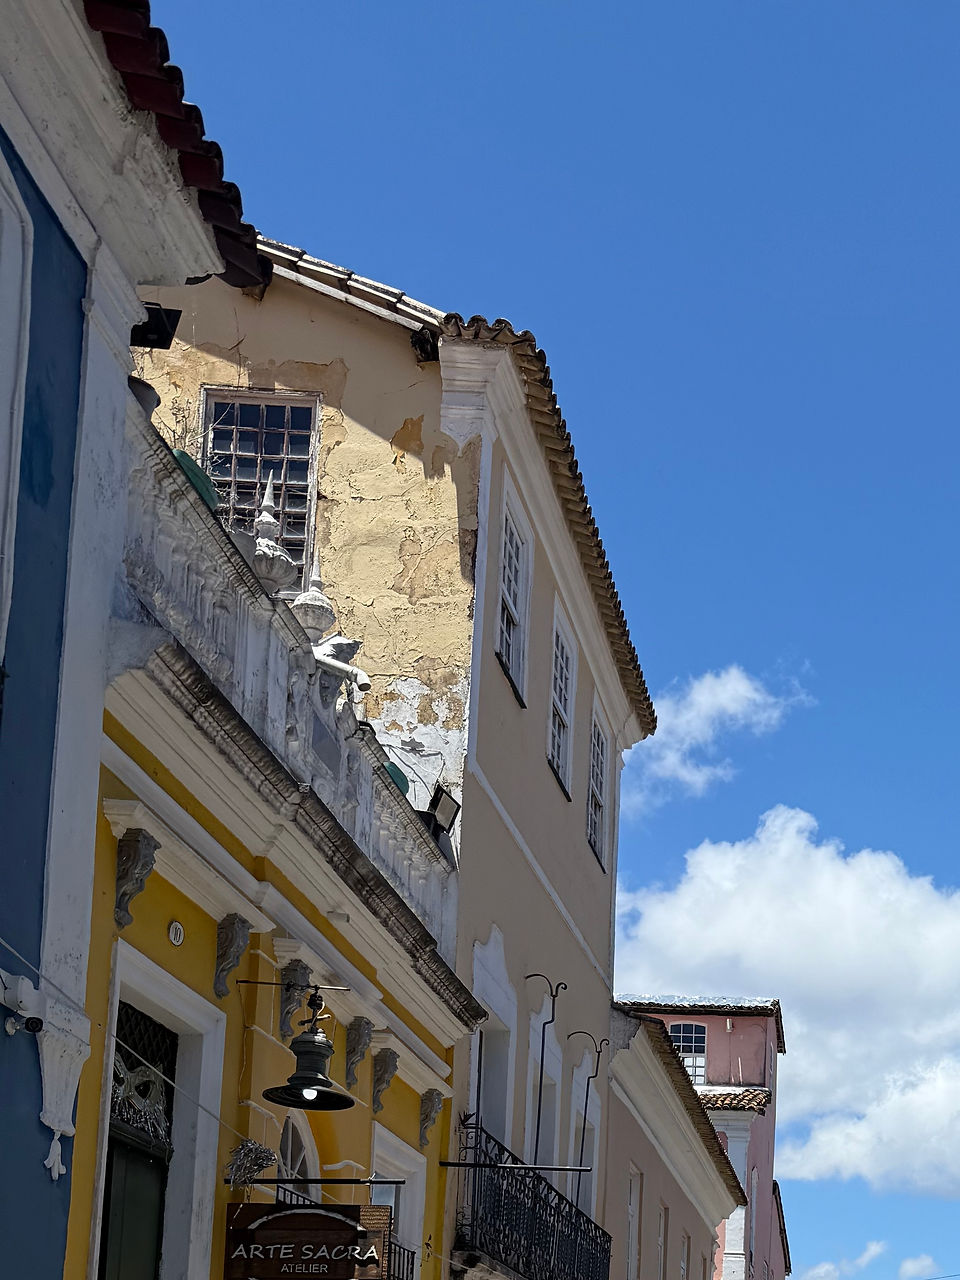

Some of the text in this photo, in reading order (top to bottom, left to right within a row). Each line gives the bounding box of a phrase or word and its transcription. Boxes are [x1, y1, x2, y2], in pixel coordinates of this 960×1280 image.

[231, 1243, 379, 1260] ARTE SACRA
[280, 1263, 328, 1273] ATELIER
